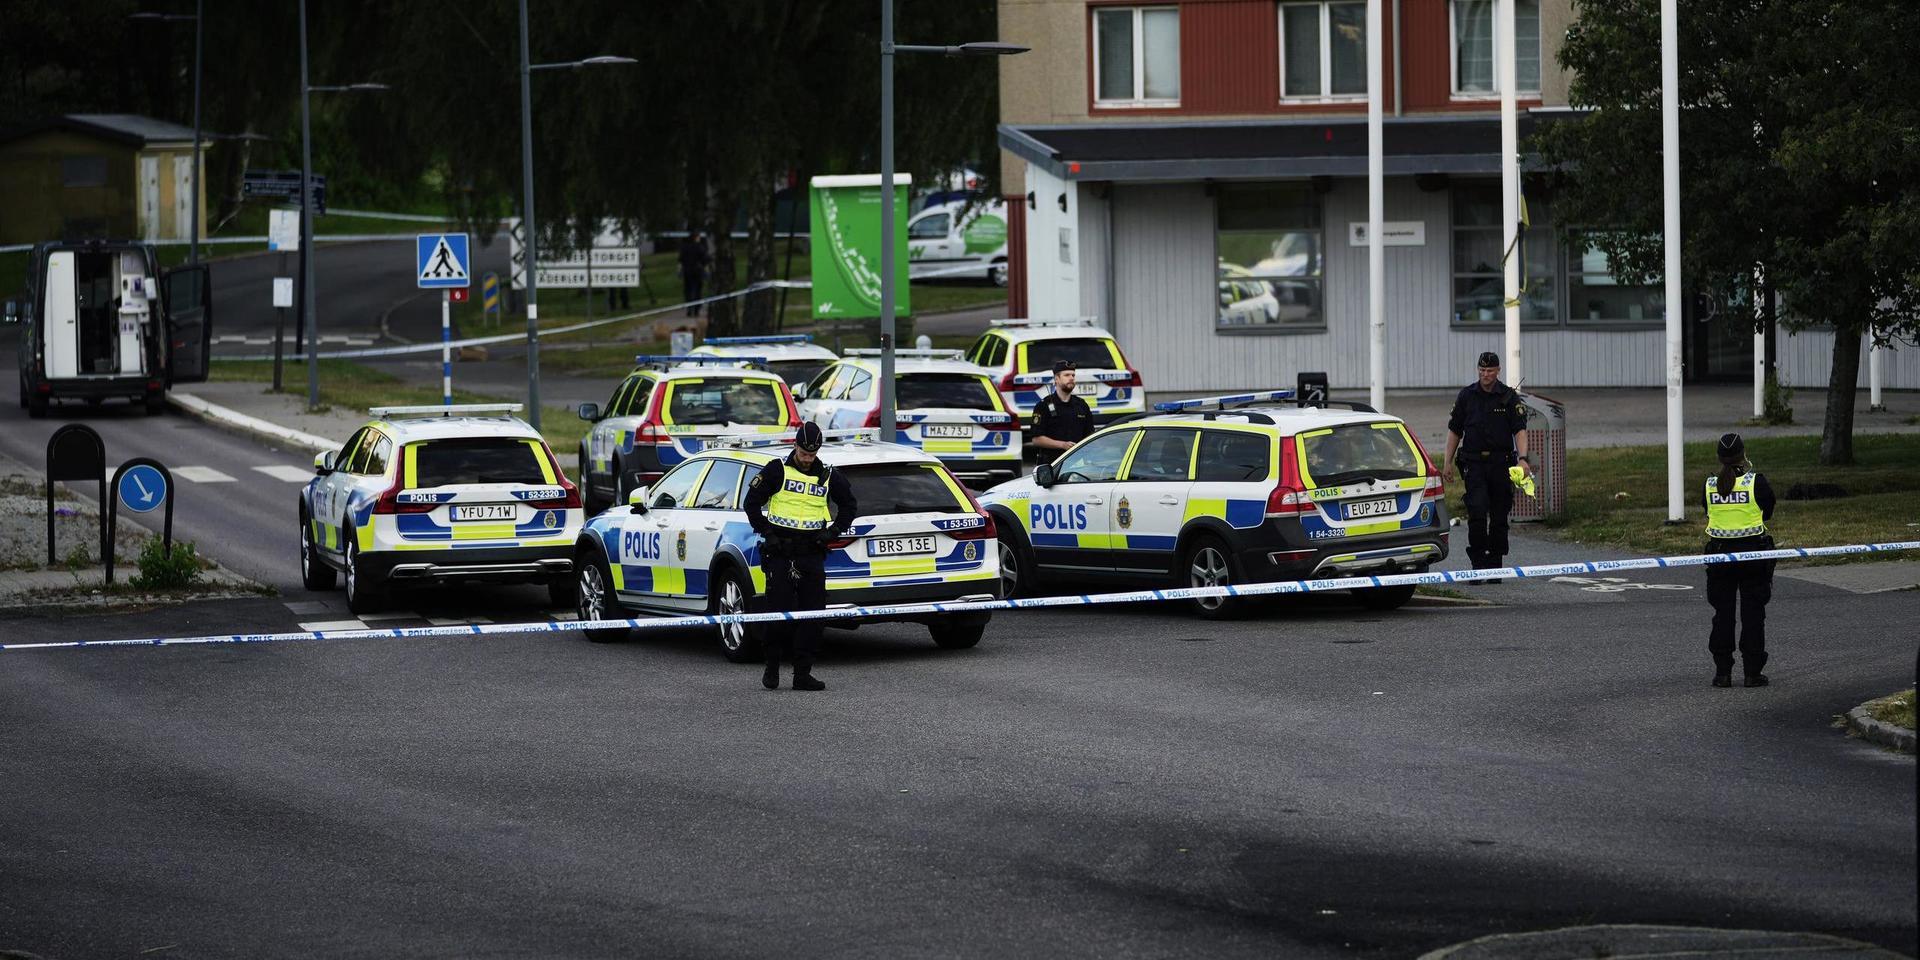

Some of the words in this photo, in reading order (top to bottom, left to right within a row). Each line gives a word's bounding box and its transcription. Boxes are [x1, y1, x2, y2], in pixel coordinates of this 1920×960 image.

[930, 426, 947, 435] MAZ
[410, 494, 438, 502] POLIS
[521, 491, 526, 499] 1
[528, 490, 560, 499] 52-2320
[1314, 489, 1339, 498] POLIS
[1711, 492, 1747, 504] POLIS
[460, 506, 485, 518] YFU
[488, 505, 512, 517] 71W
[1352, 504, 1371, 516] EUP
[1374, 500, 1393, 513] 227
[1030, 503, 1088, 530] POLIS
[943, 521, 947, 529] 1
[950, 518, 979, 527] 53-5110
[1317, 529, 1346, 537] 54-3320
[624, 531, 661, 560] POLIS
[880, 540, 904, 553] BRS
[907, 538, 931, 551] 13E
[1703, 556, 1726, 564] POLIS
[1739, 552, 1763, 560] POLIS
[1561, 566, 1584, 574] POLIS
[1598, 561, 1621, 570] POLIS
[1455, 570, 1478, 579] POLIS
[1418, 576, 1441, 584] POLIS
[1311, 581, 1335, 589] POLIS
[1167, 590, 1191, 598] POLIS
[721, 614, 746, 623] POLIS
[564, 621, 588, 630] POLIS
